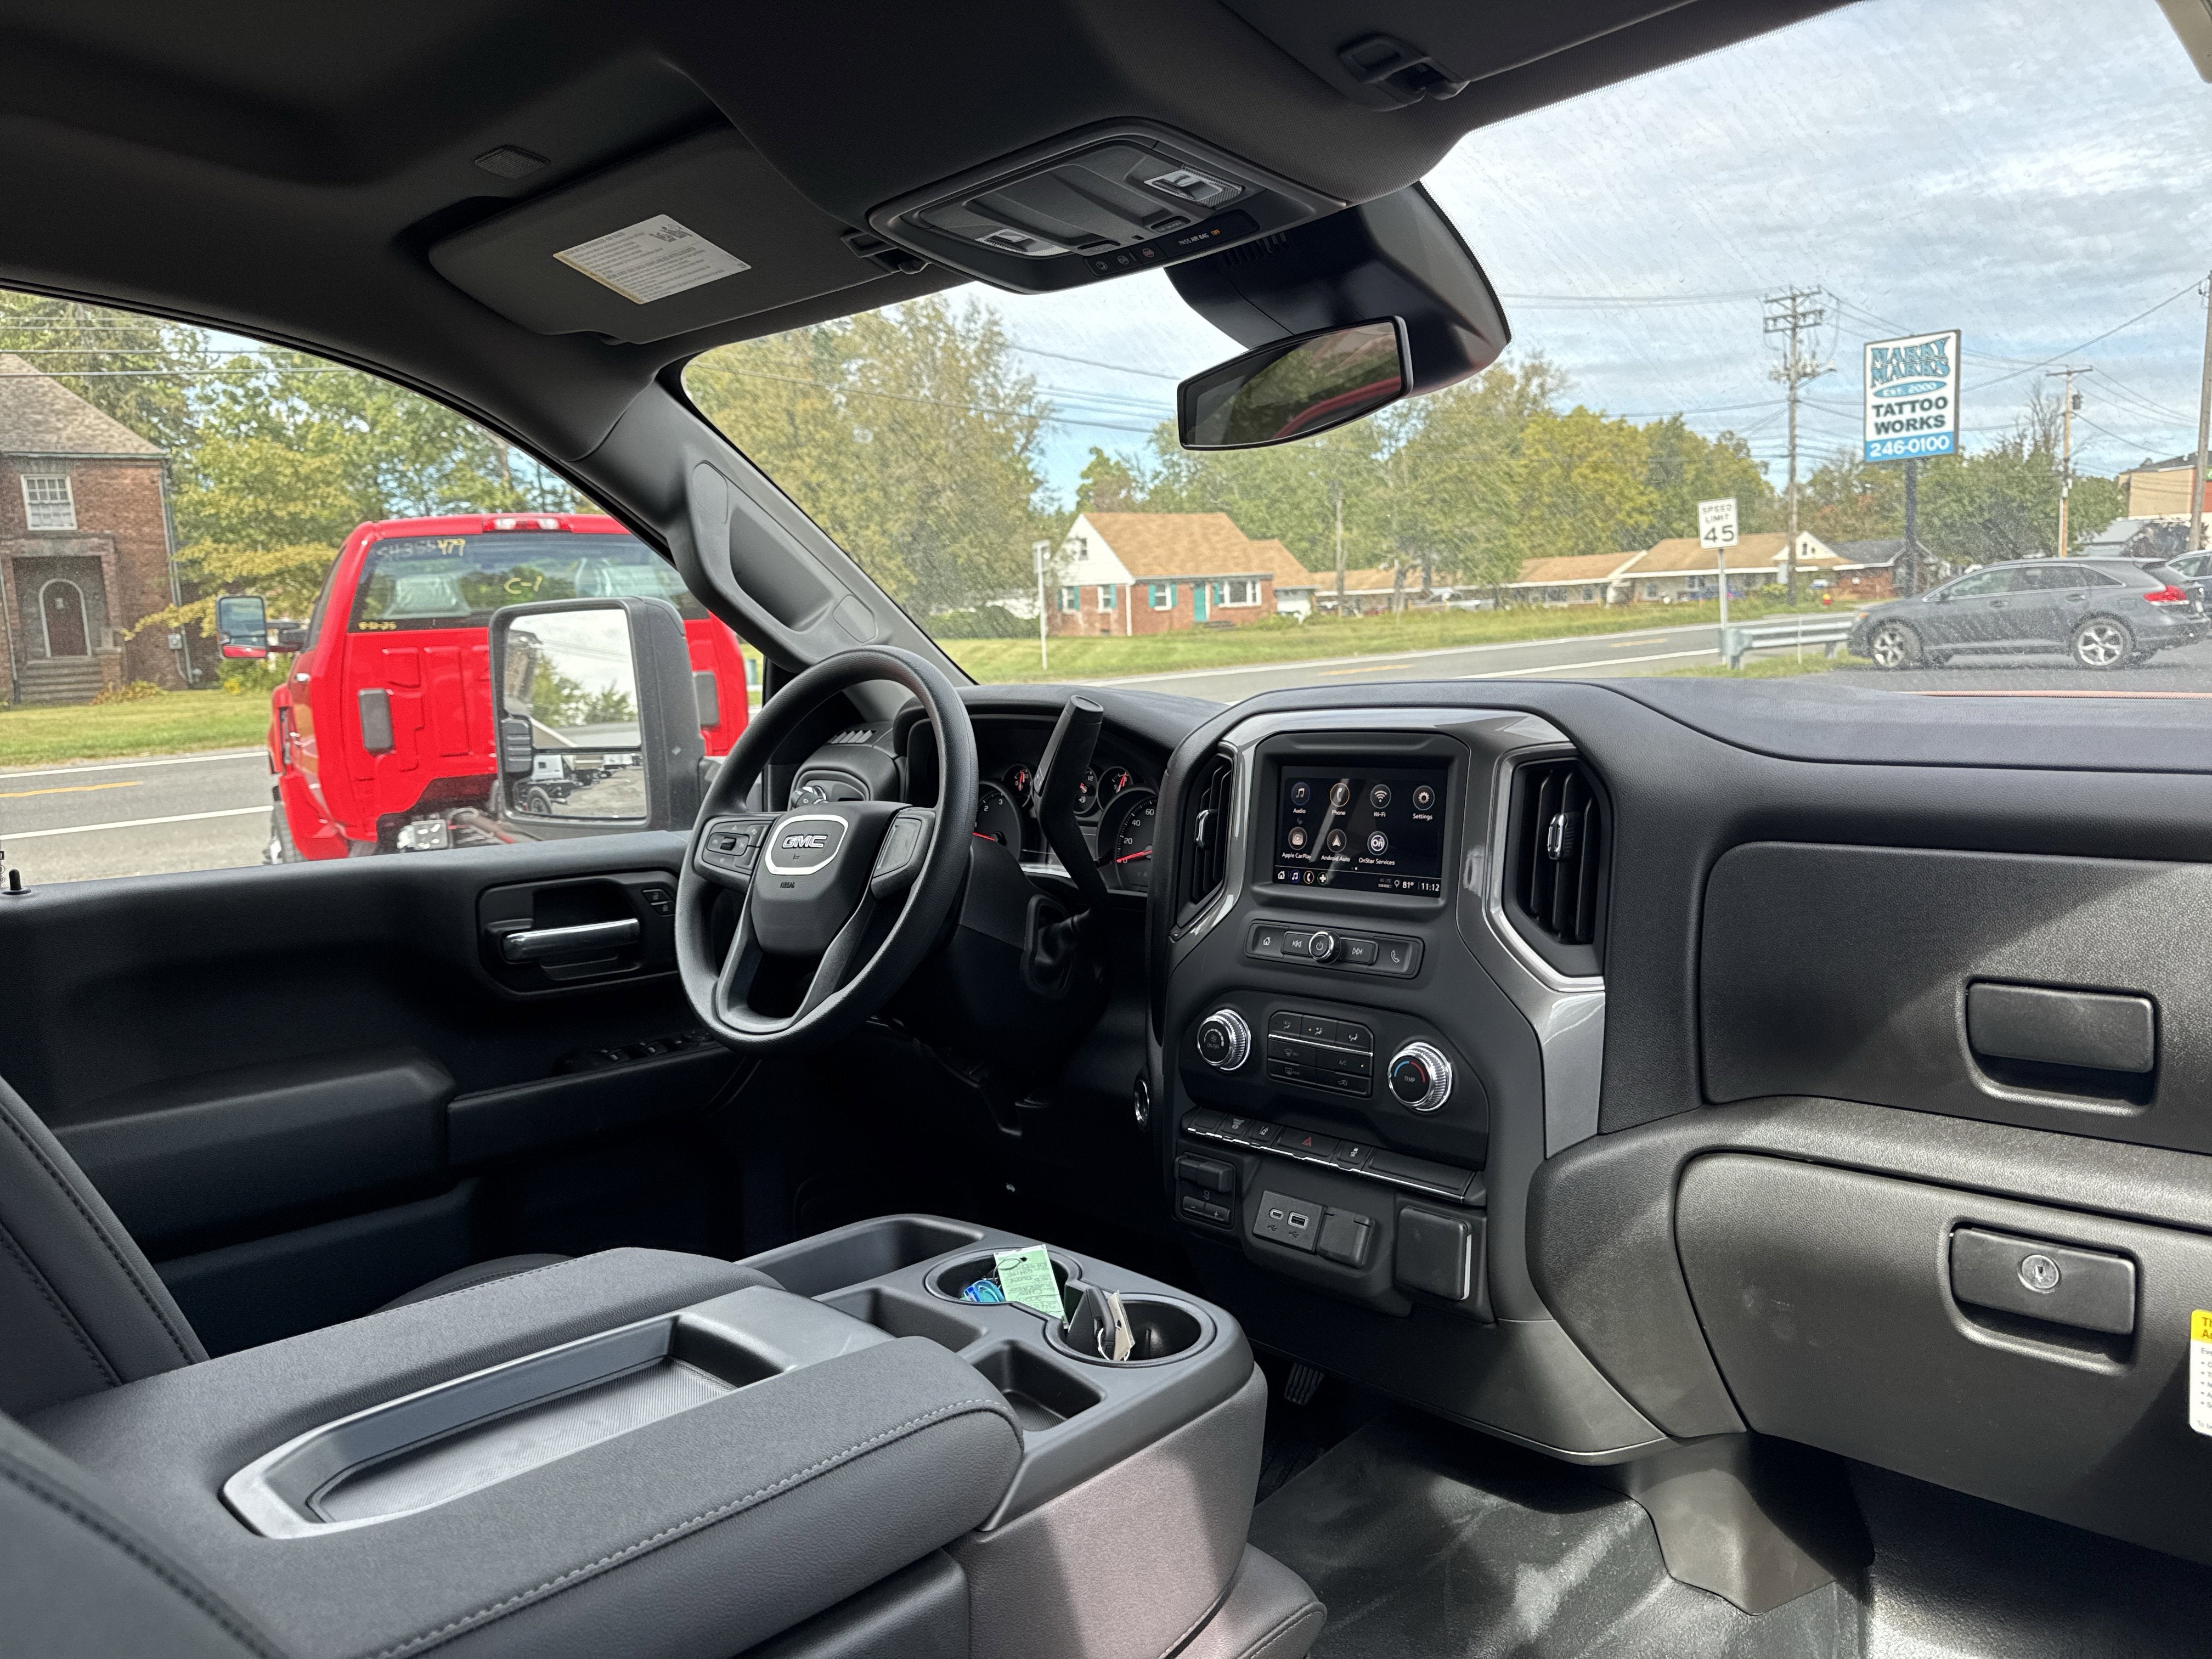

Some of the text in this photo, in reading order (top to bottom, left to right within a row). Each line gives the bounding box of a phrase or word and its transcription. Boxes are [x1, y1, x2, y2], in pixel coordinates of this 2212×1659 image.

[1870, 336, 1951, 367] MARKY
[1870, 357, 1950, 388] MARKS
[1908, 382, 1937, 393] 2000
[1871, 396, 1948, 417] TATTOO
[1874, 414, 1946, 435] WORKS
[1870, 435, 1950, 458] 246-0100
[1702, 504, 1732, 514] SPEED
[1705, 514, 1729, 524] LIMIT
[1703, 524, 1734, 543] 45
[504, 576, 543, 594] C-1
[782, 834, 828, 849] GMC
[1421, 883, 1440, 891] 11:12
